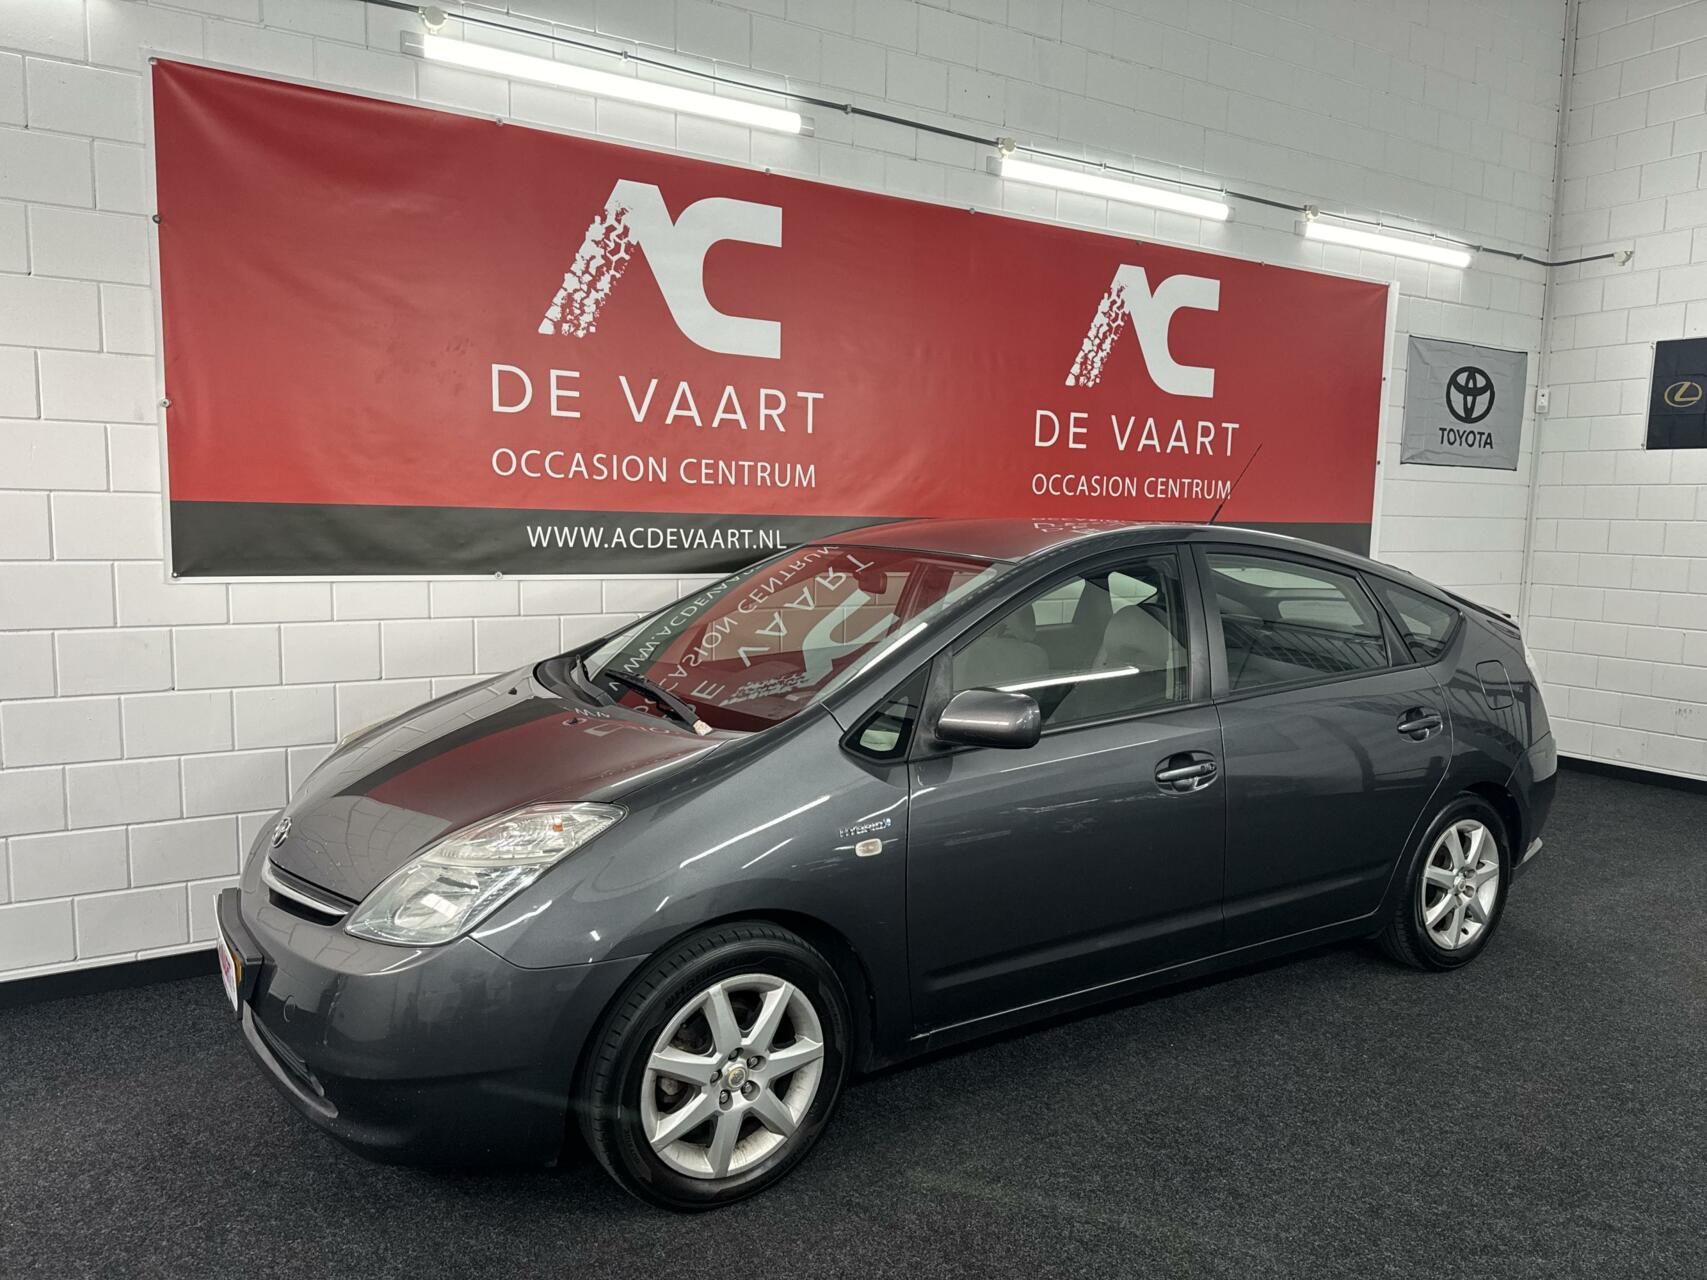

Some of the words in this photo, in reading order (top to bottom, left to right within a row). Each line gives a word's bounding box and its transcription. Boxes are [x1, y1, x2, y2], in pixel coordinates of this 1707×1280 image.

[538, 178, 783, 359] AC
[1065, 263, 1221, 398] AC
[491, 363, 581, 418] DE
[618, 375, 824, 434] VAART
[1034, 409, 1089, 449] DE
[1111, 414, 1240, 456] VAART
[1438, 426, 1494, 450] TOYOTA
[491, 447, 667, 482] OCCASION
[679, 458, 816, 488] CENTRUM
[1031, 473, 1137, 497] OCCASION
[1144, 477, 1231, 500] CENTRUM
[526, 525, 787, 549] WWW.ACDEVAART.NL
